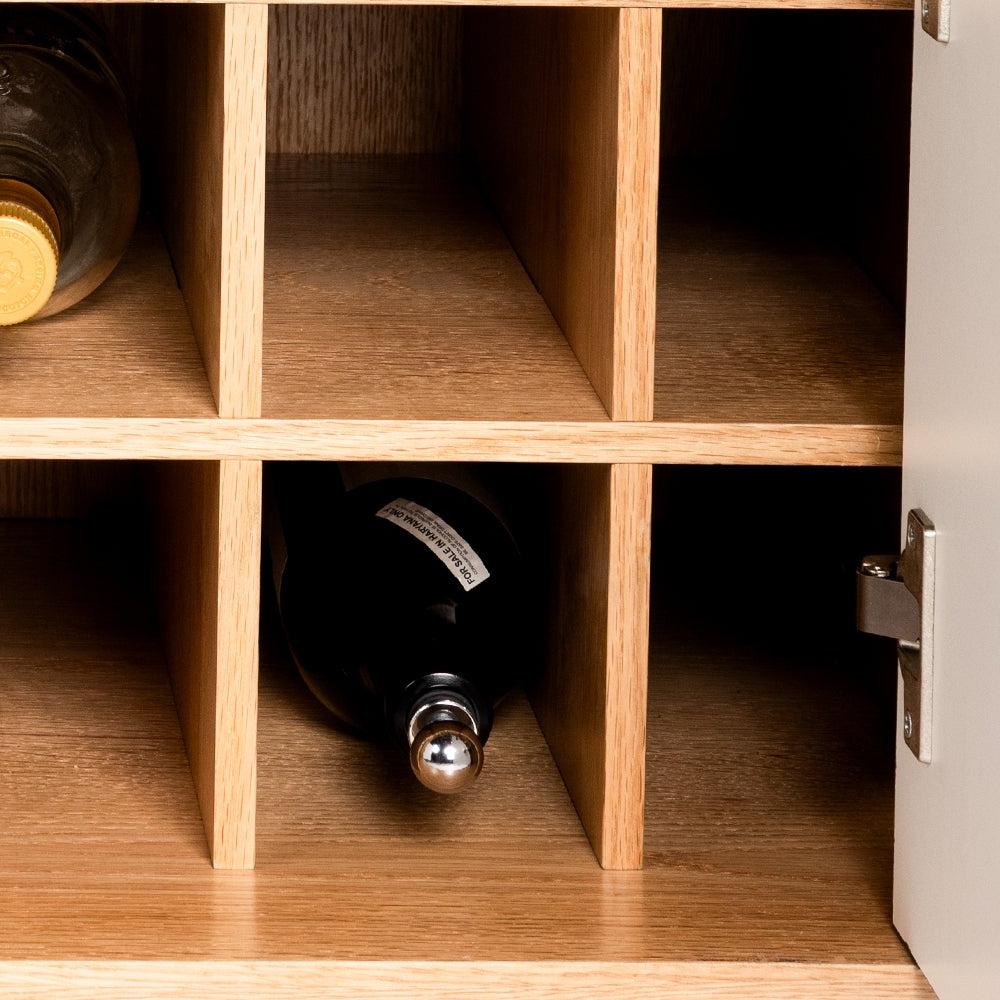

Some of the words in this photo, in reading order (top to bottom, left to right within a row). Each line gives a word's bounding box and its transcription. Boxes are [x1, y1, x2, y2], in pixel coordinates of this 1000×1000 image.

[383, 507, 405, 519] ONLY
[404, 516, 437, 542] HARYANA
[436, 540, 447, 552] IN
[443, 549, 463, 567] SALE
[459, 567, 475, 585] FOR
